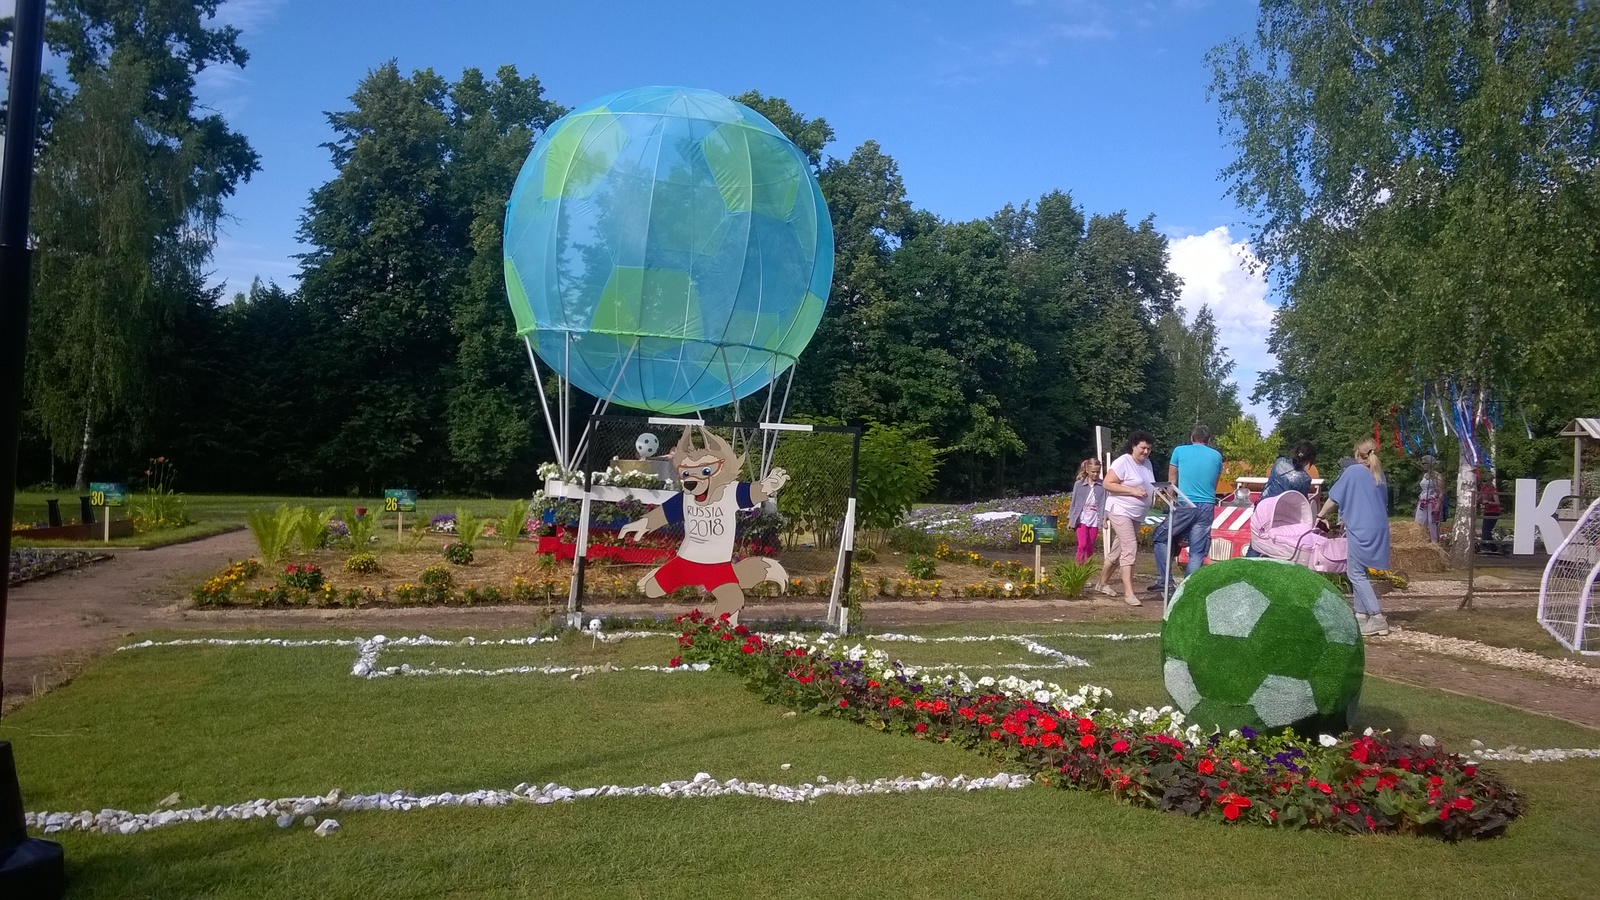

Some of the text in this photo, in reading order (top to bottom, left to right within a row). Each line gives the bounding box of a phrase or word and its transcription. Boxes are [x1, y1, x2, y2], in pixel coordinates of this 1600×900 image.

[91, 491, 104, 506] 30
[386, 497, 397, 511] 26
[687, 505, 723, 518] RUSSIA
[689, 518, 724, 537] 2018
[1021, 523, 1034, 543] 25
